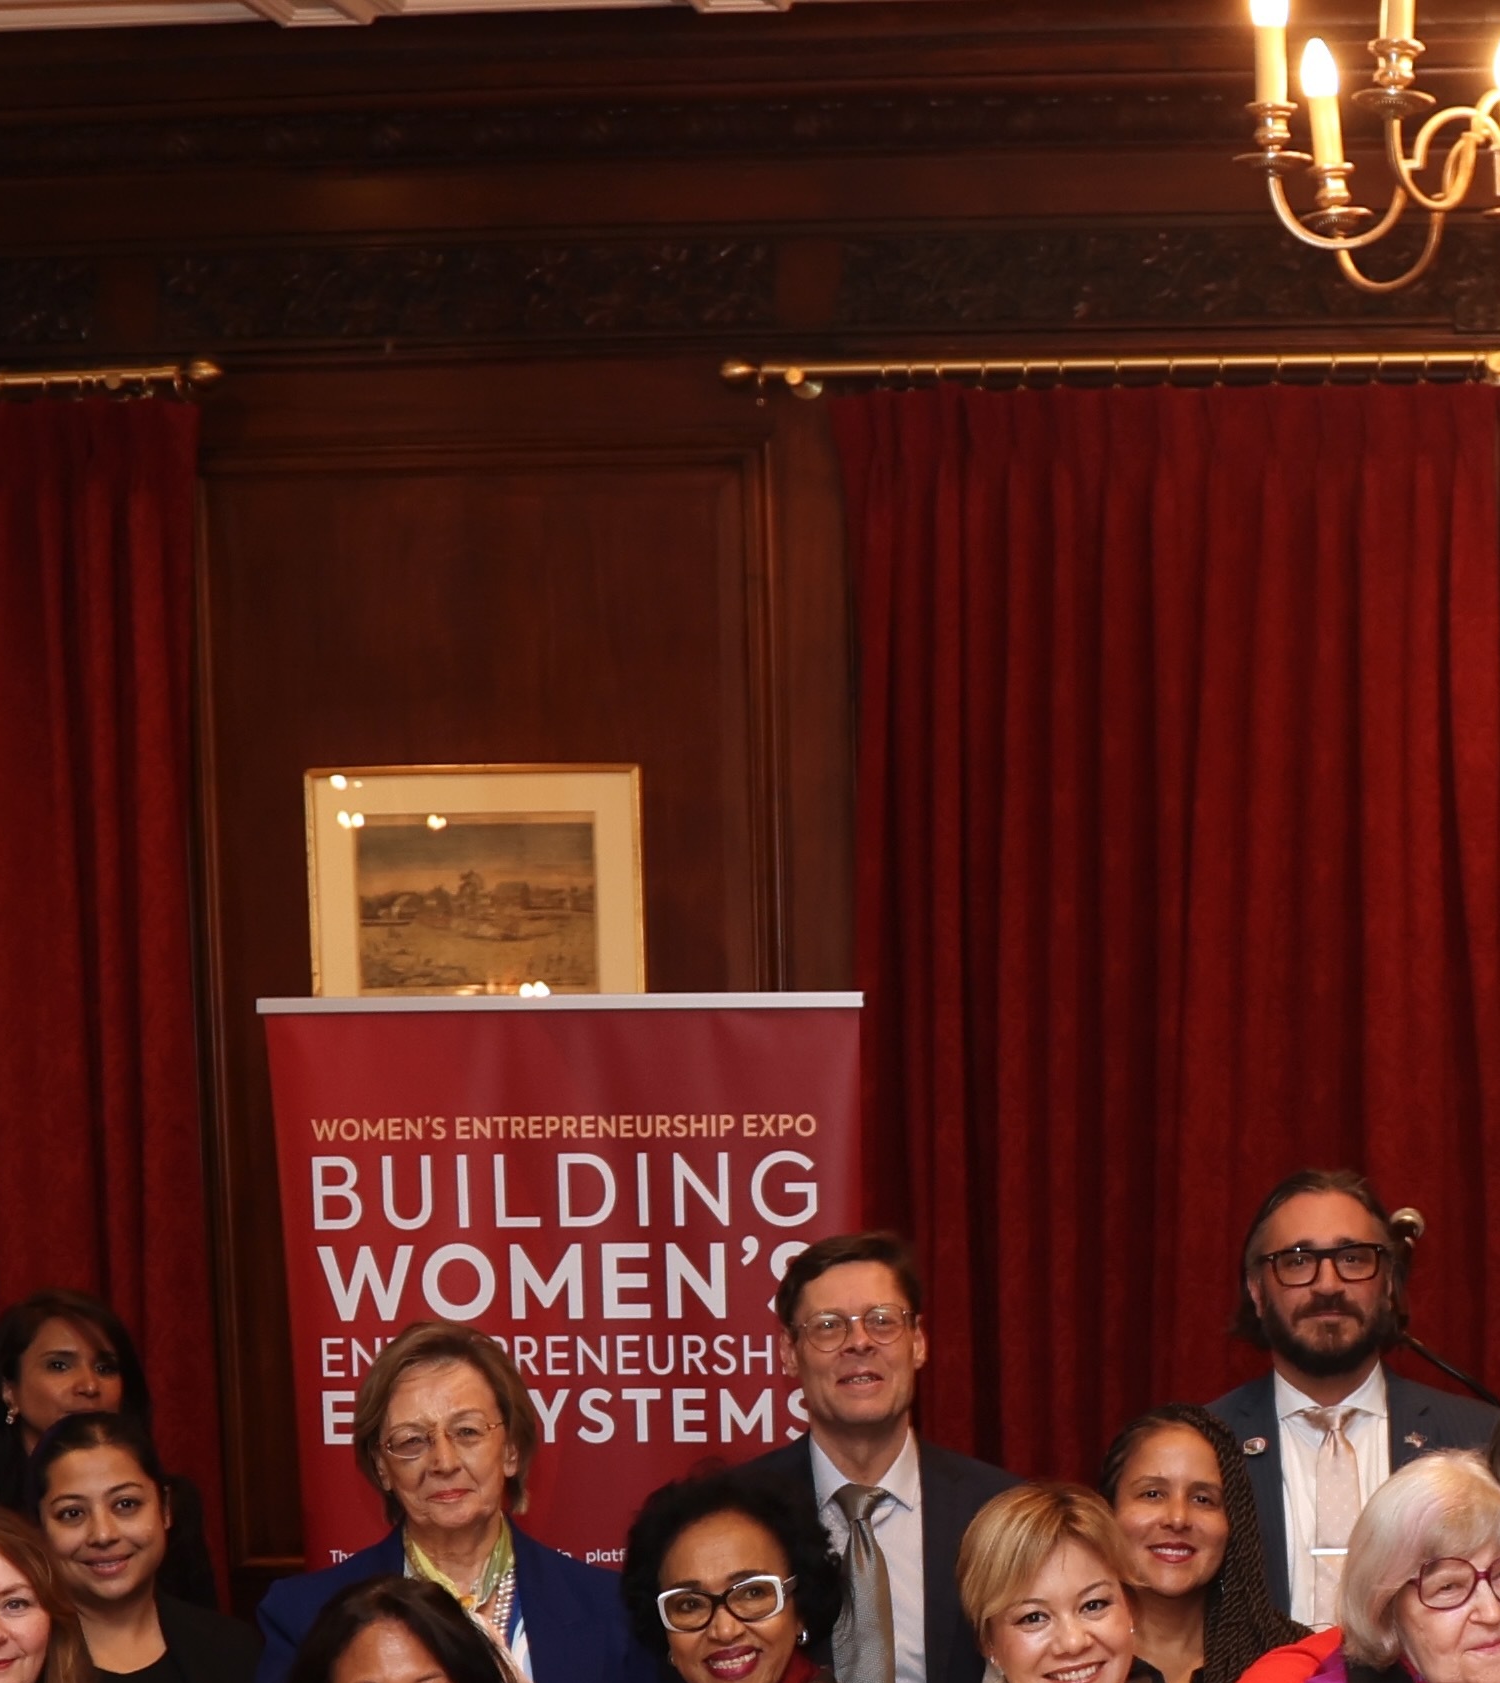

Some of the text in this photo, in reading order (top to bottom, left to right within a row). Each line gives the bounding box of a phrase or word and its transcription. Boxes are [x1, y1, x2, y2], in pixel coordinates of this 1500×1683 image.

[311, 1113, 818, 1142] WOMEN'S ENTREPRENEURSHIP EXPO
[311, 1150, 819, 1231] BUILDING
